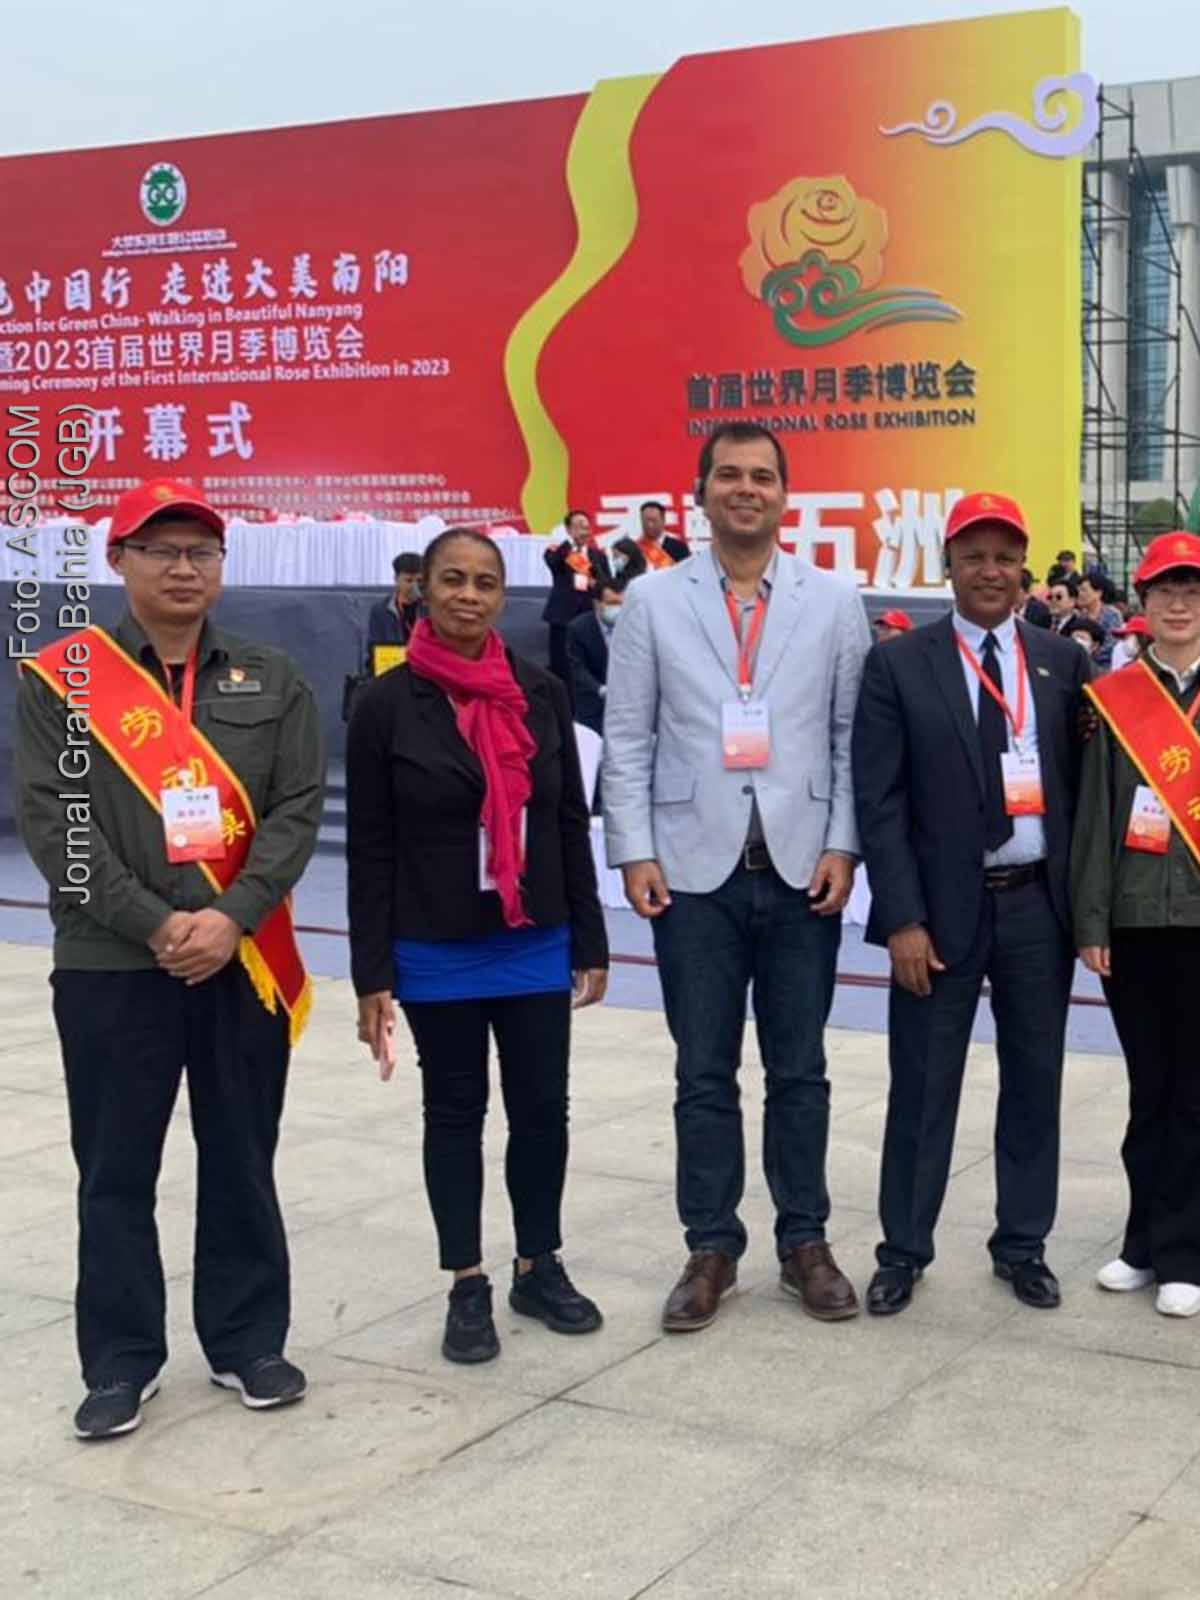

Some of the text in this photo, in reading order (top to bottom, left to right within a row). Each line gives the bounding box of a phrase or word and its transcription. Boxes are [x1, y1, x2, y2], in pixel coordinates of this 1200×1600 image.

[161, 249, 409, 304] 走进大美南阳
[58, 315, 98, 332] Green
[147, 308, 205, 328] Walking
[225, 303, 292, 323] Beautiful
[295, 303, 363, 322] Nanyang
[143, 369, 175, 386] First
[177, 364, 271, 384] International
[274, 364, 309, 381] Rose
[313, 361, 390, 379] Exhibition
[412, 358, 450, 377] 2023
[687, 359, 976, 412] 首届世界月季博览会
[84, 400, 255, 462] 开幕式
[874, 407, 976, 430] EXHIBITION
